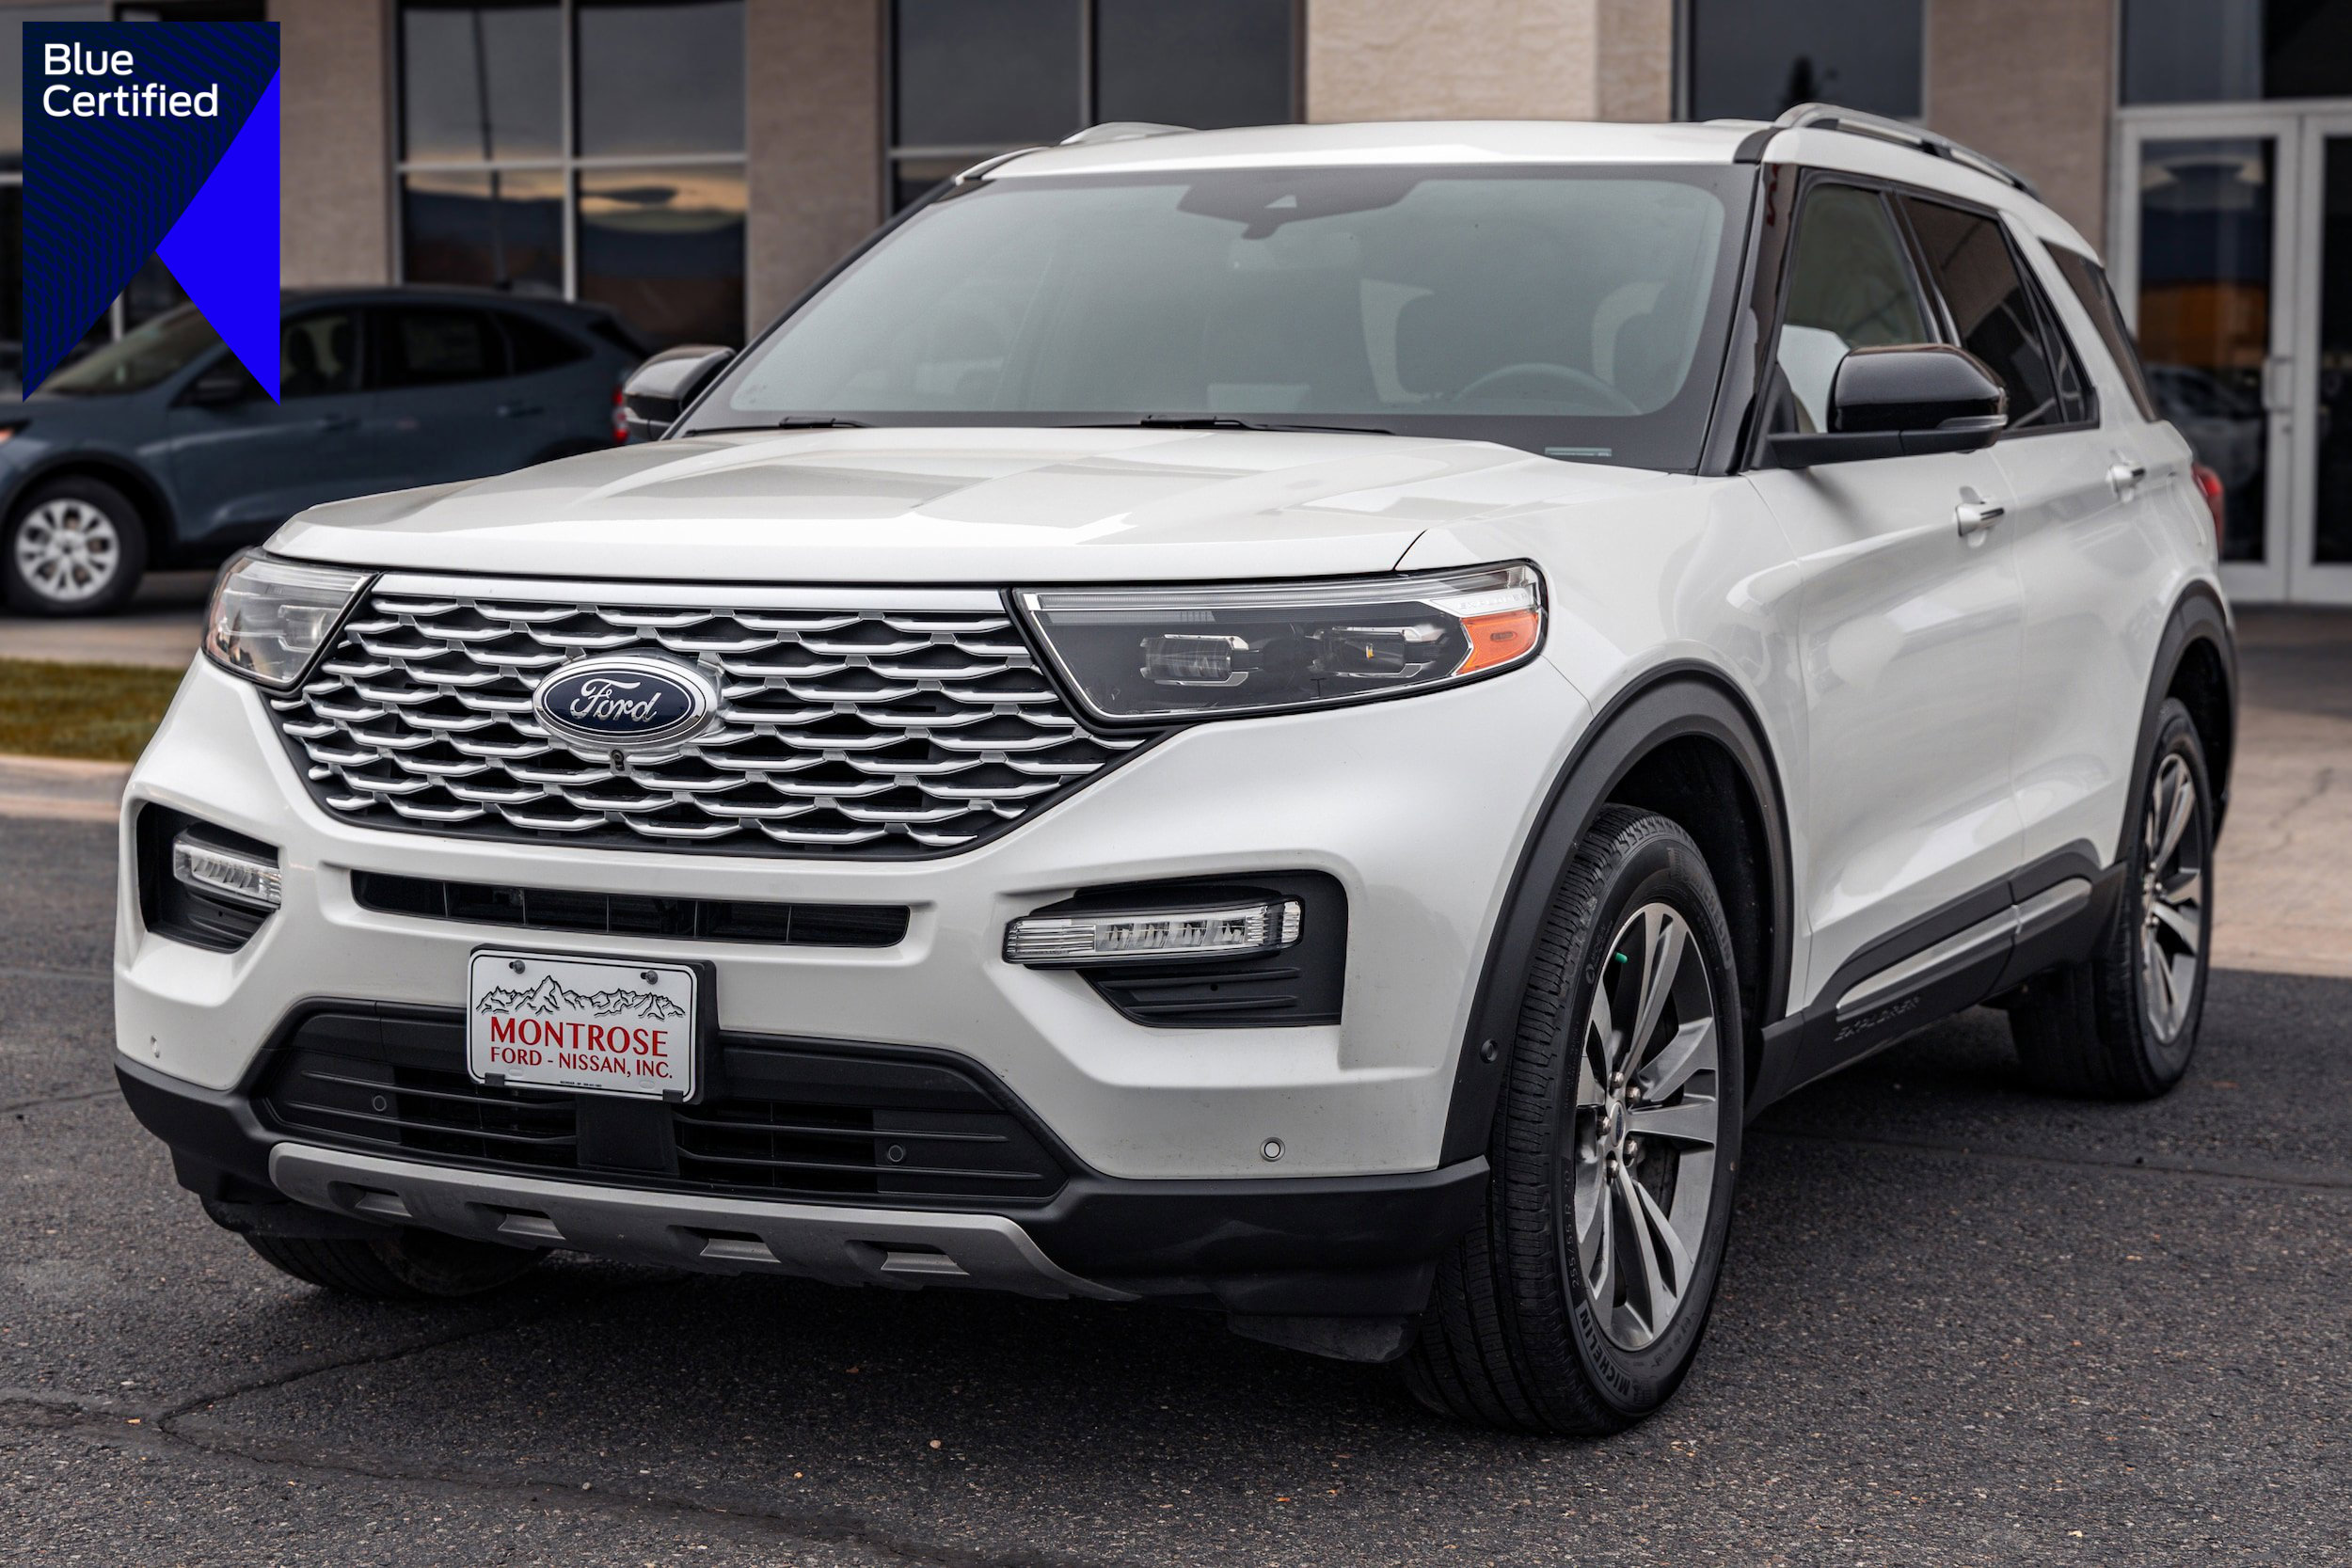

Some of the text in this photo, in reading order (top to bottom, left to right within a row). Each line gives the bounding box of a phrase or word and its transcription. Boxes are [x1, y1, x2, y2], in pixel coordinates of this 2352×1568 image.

[569, 677, 662, 723] Ford
[490, 1016, 669, 1058] MONTROSE
[490, 1046, 543, 1067] FORD
[558, 1052, 631, 1079] NISSAN,
[636, 1058, 674, 1080] INC.
[1564, 1170, 1581, 1289] 255/55 R 20
[1580, 1307, 1631, 1396] MICHELIN
